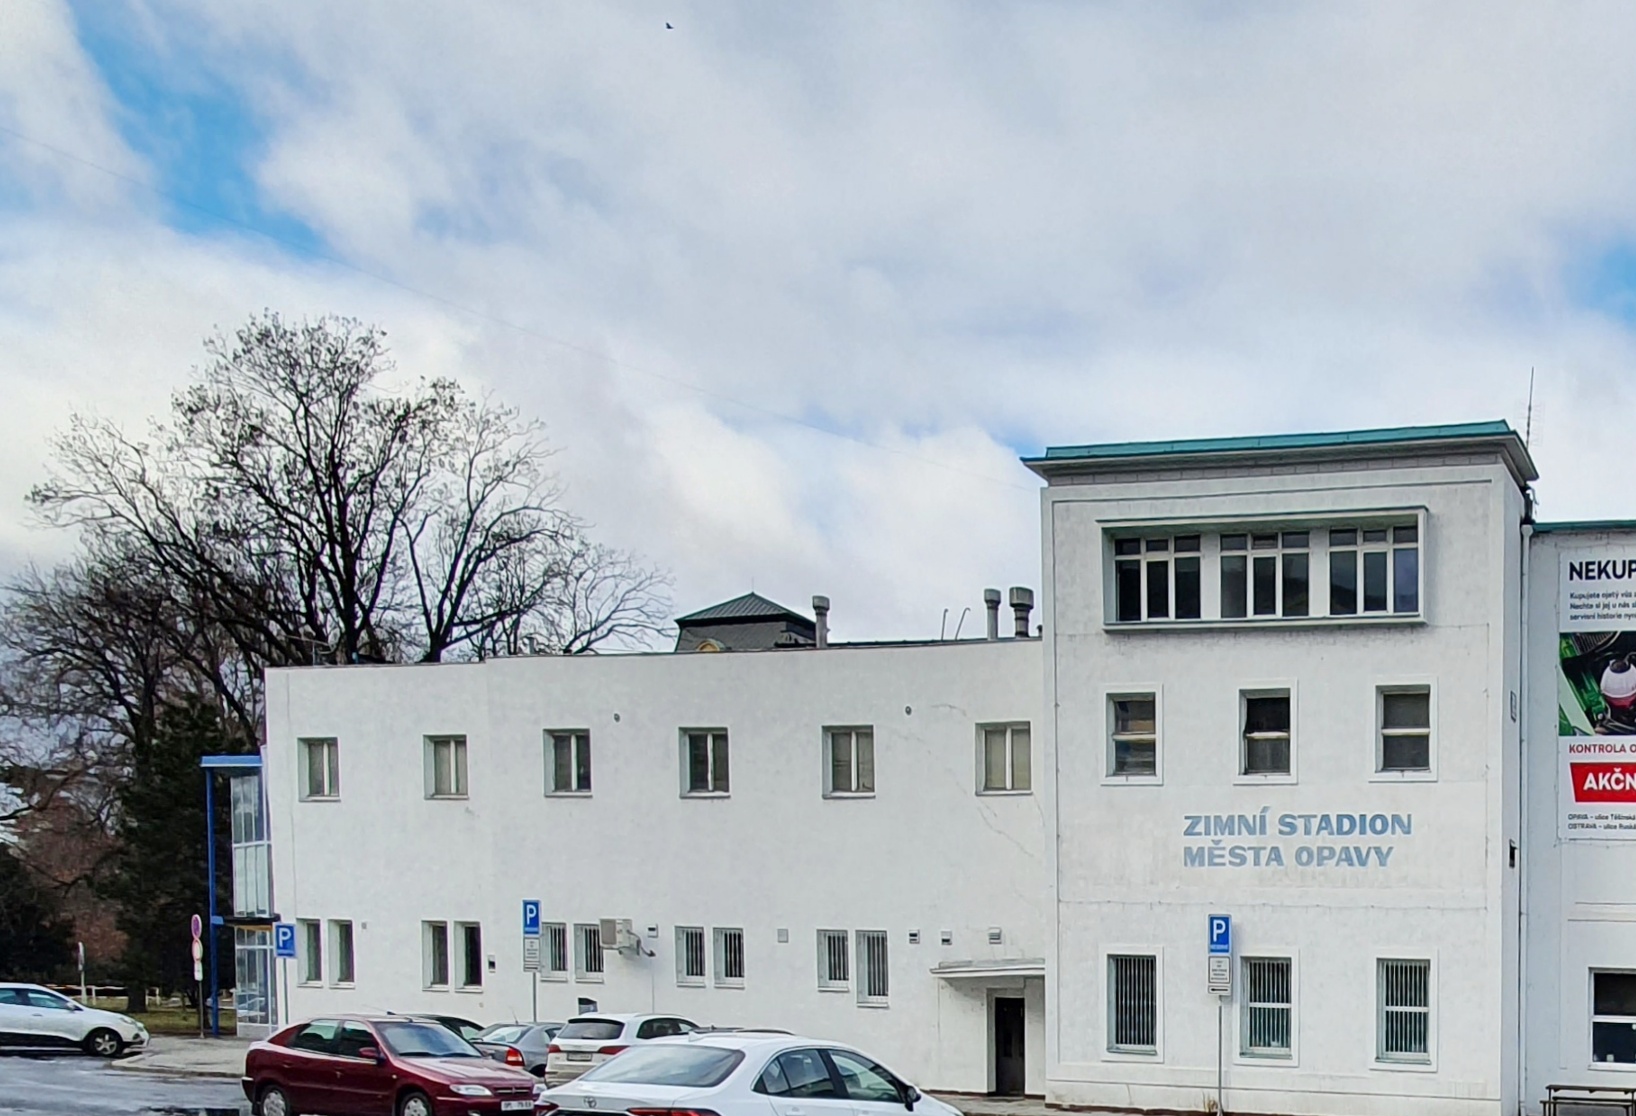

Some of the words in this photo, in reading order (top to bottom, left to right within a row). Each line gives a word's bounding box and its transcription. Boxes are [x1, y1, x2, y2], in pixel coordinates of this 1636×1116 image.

[1570, 592, 1600, 601] Kupujete
[1569, 743, 1626, 755] KONTROLA
[1183, 806, 1270, 836] ZIMNÍ
[1278, 814, 1412, 836] STADION
[1183, 839, 1284, 867] MĚSTA
[1294, 846, 1394, 867] OPAVY
[526, 904, 537, 925] P
[279, 928, 291, 947] P
[1213, 919, 1226, 942] P
